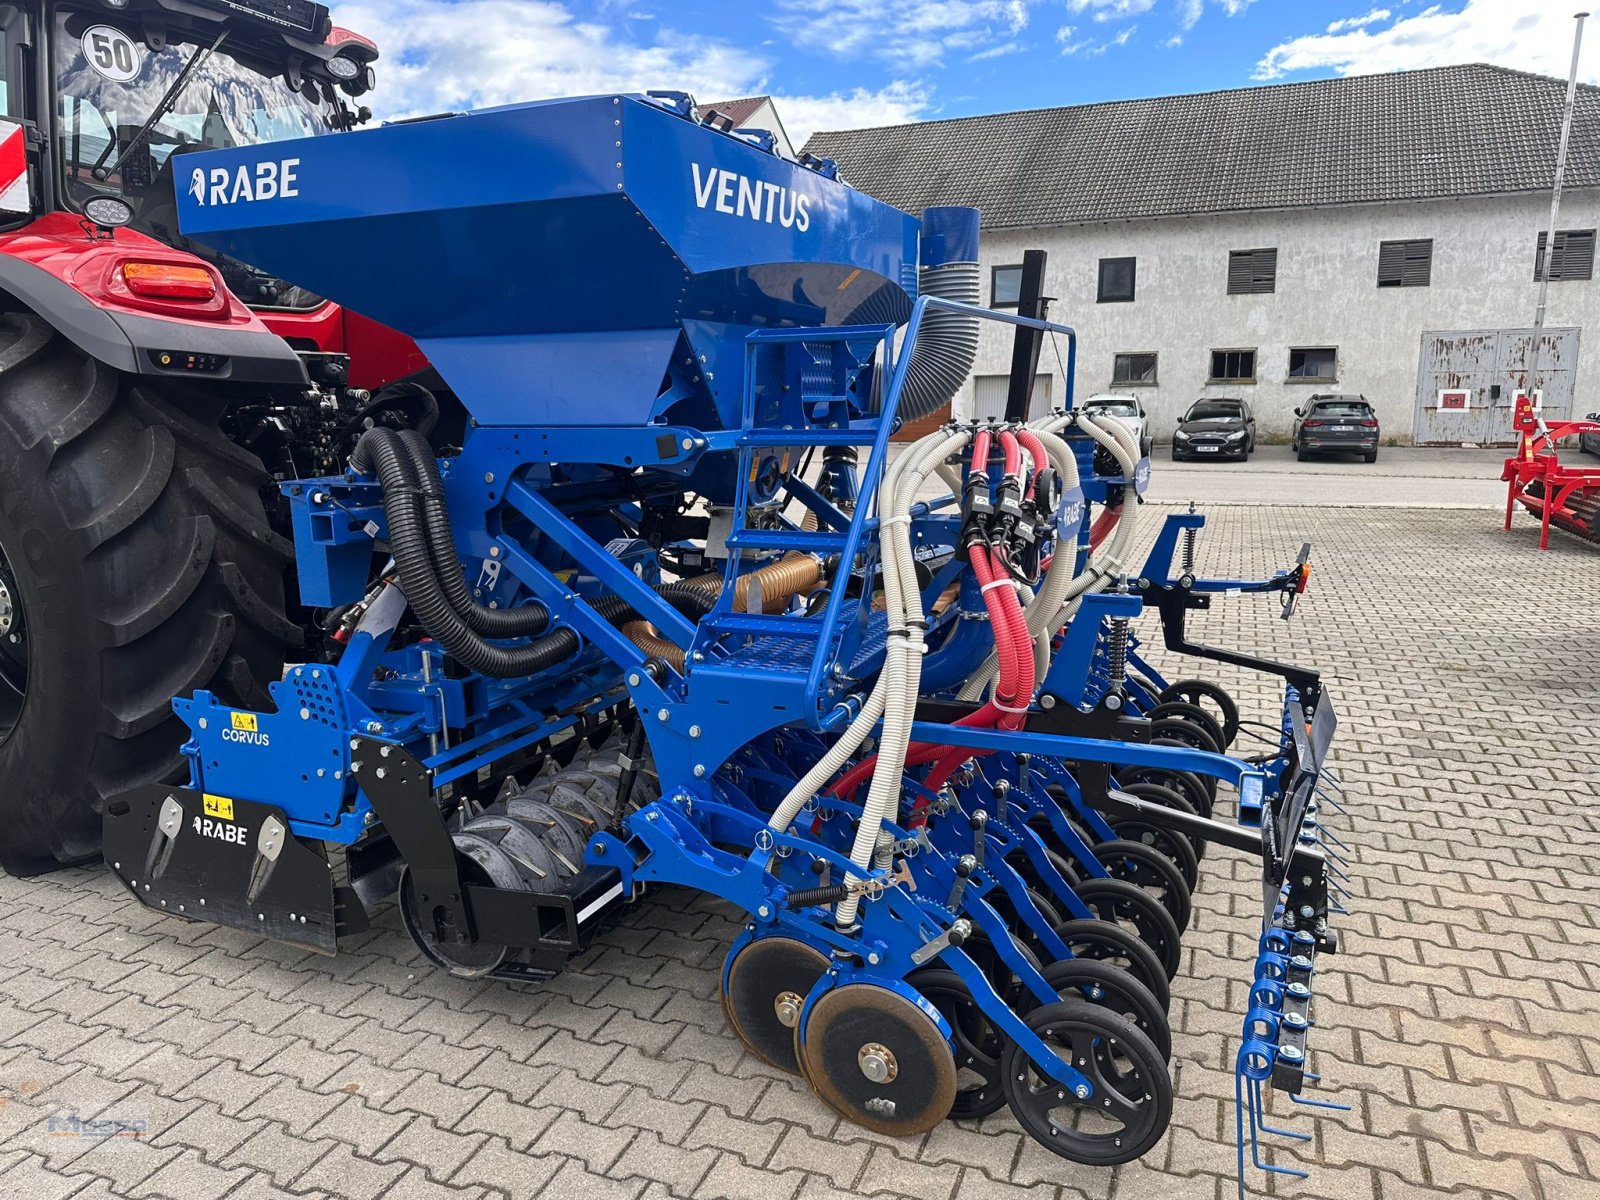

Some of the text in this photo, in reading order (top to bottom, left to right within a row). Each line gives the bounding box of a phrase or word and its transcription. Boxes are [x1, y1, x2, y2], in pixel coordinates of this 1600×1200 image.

[92, 33, 133, 73] 50
[210, 158, 300, 206] RABE
[691, 162, 810, 232] VENTUS
[222, 728, 270, 746] CORVUS
[203, 818, 248, 846] RABE
